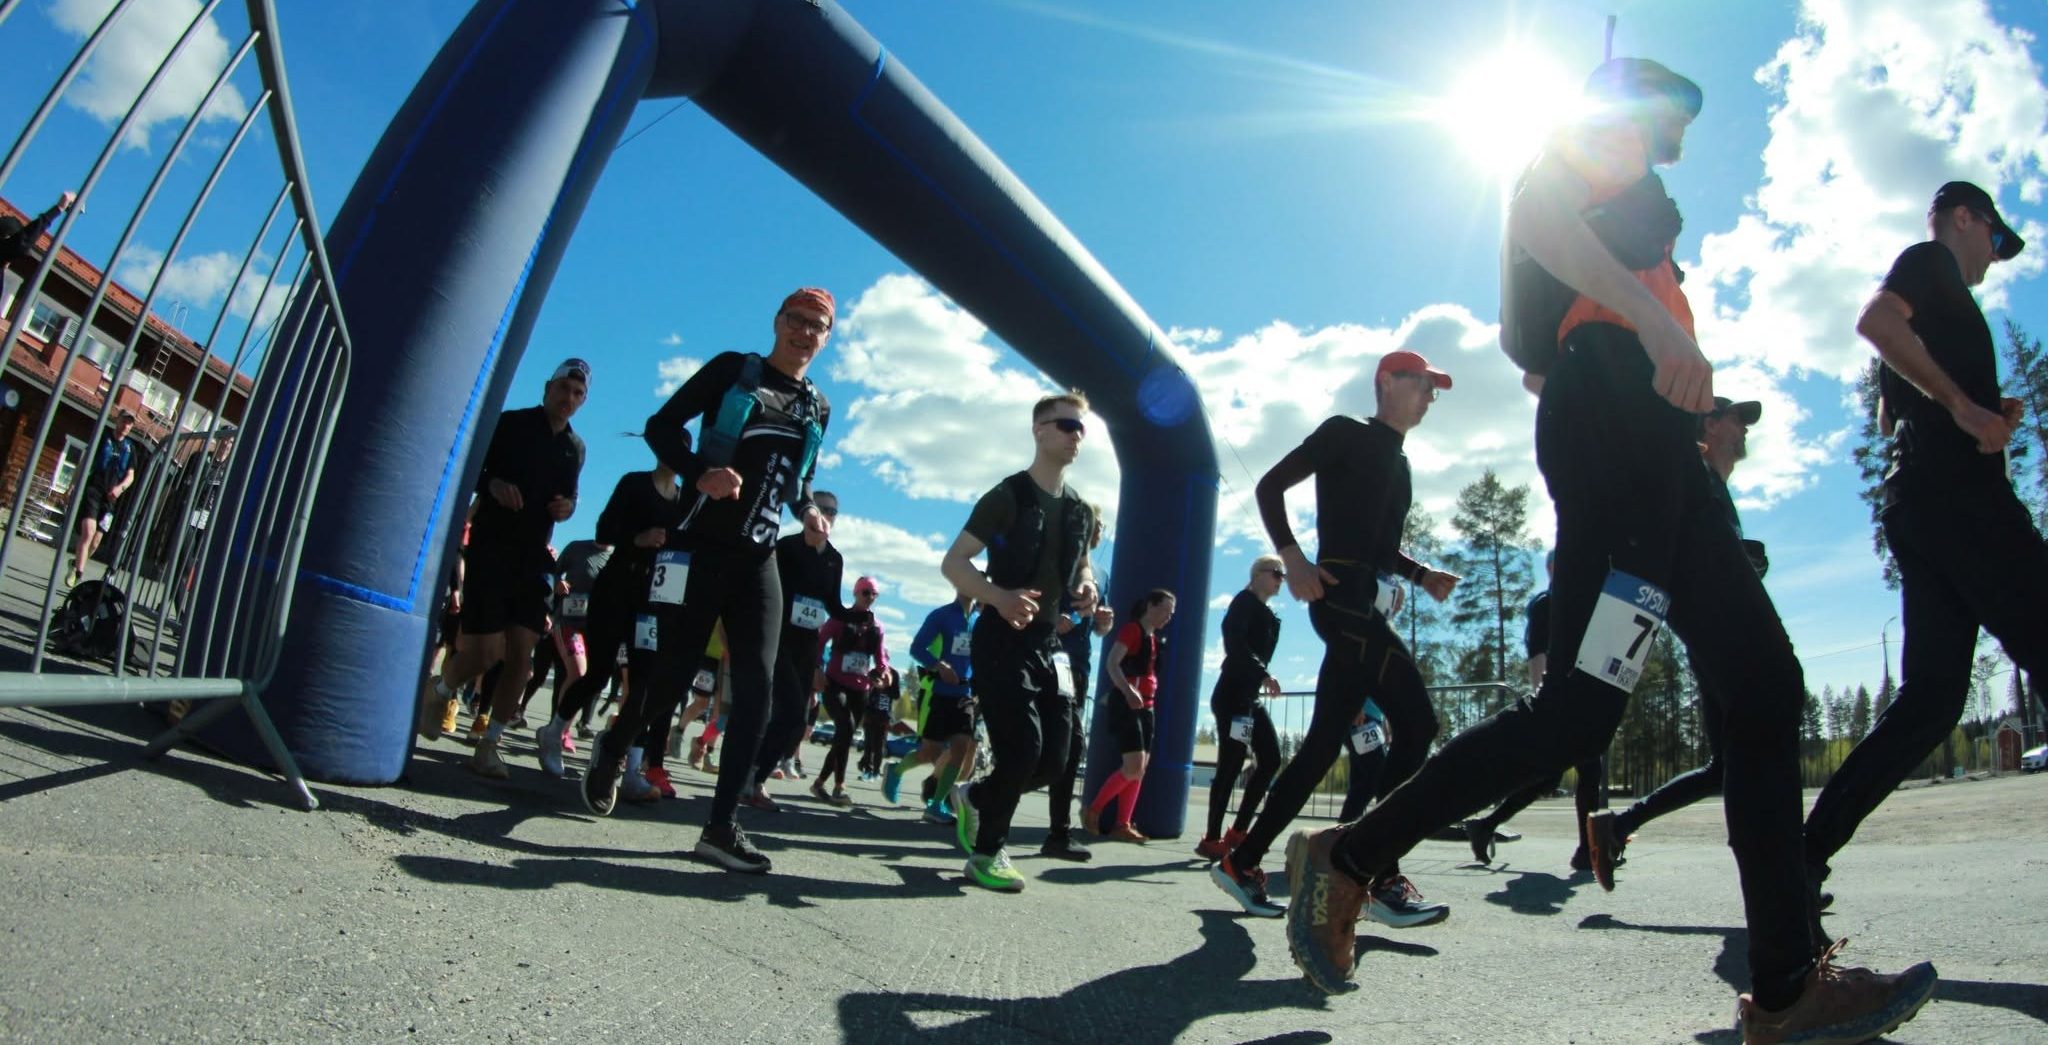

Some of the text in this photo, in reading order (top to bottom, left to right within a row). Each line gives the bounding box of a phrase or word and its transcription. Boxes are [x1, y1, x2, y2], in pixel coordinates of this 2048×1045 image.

[766, 452, 778, 473] Club
[801, 606, 817, 619] 44
[1362, 729, 1379, 744] 29
[1311, 873, 1328, 926] HOKA
